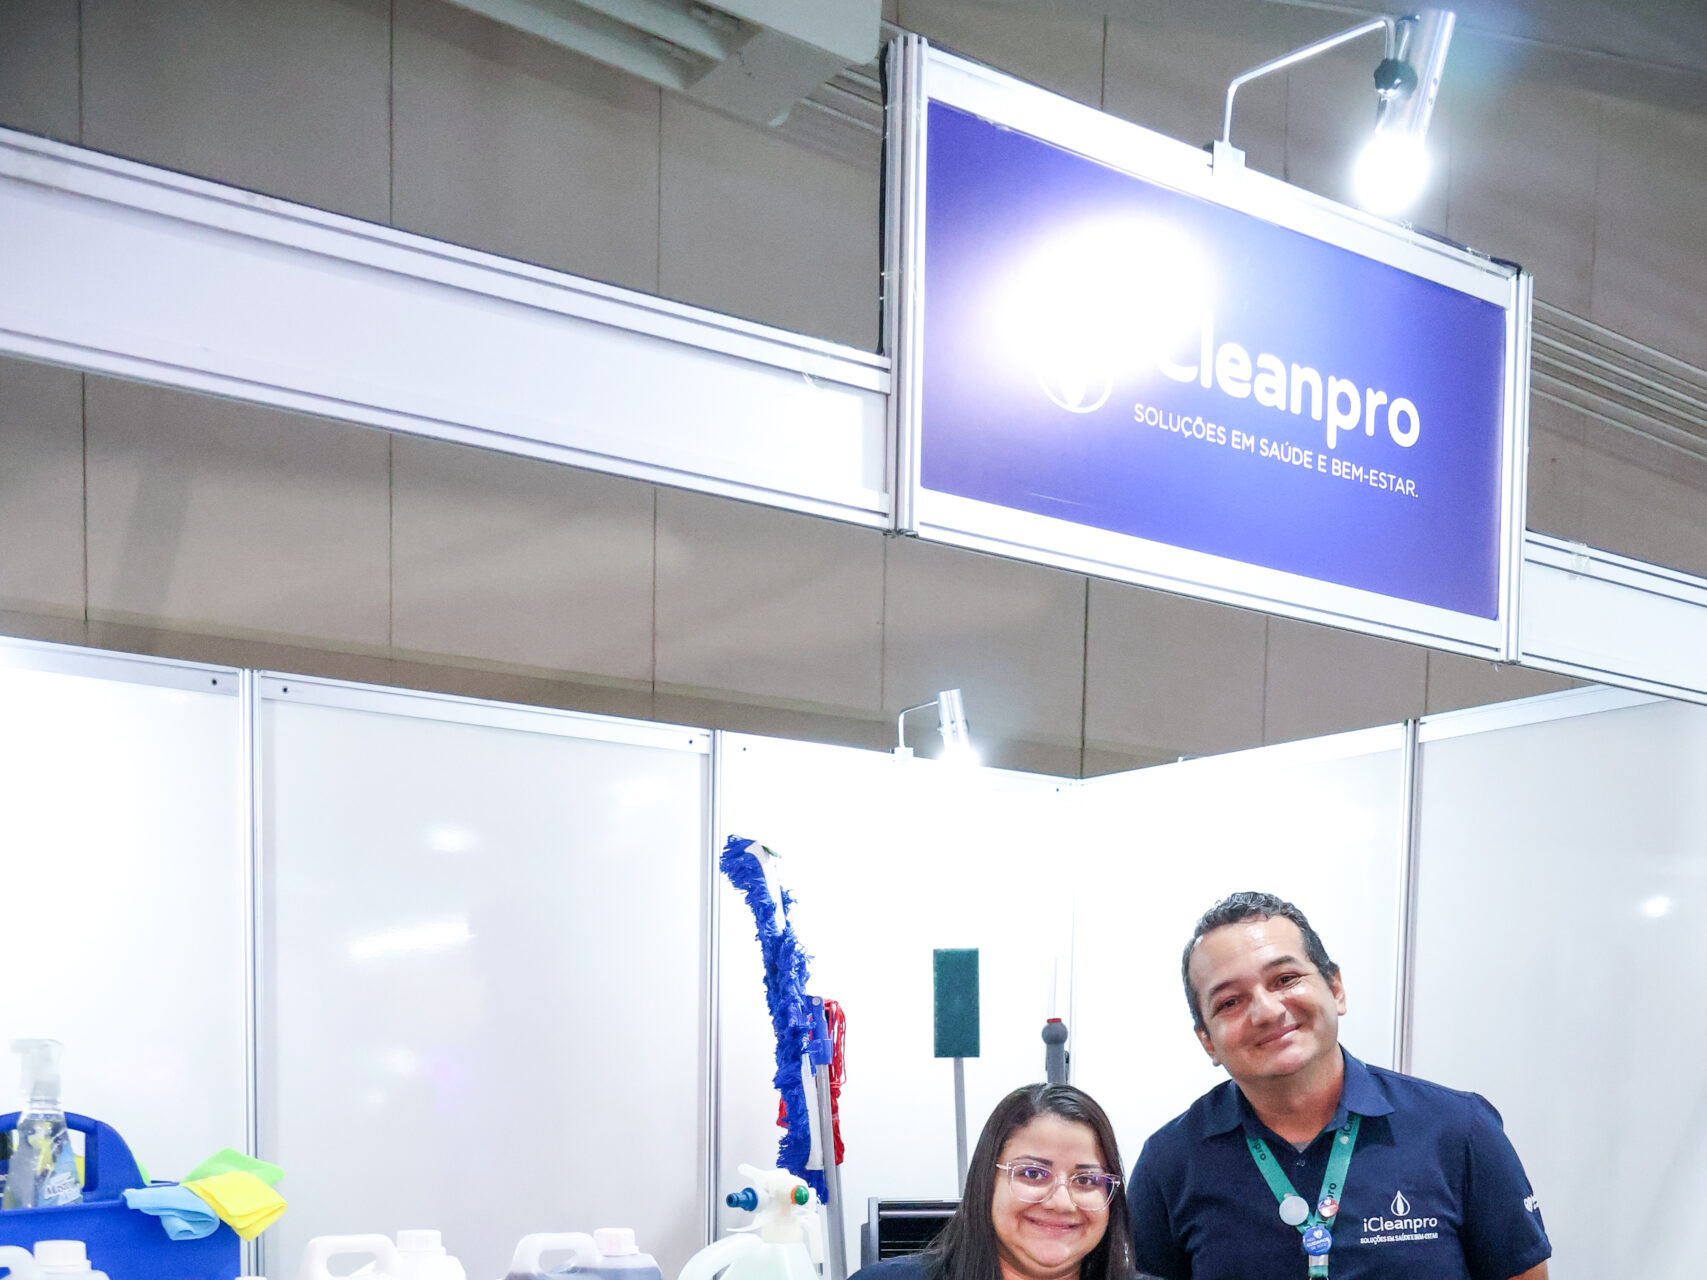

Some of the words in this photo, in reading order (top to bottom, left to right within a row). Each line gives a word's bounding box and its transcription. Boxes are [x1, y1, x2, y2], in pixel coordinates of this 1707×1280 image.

[1134, 403, 1227, 446] SOLUÇÕES
[1231, 430, 1255, 453] EM
[1259, 439, 1313, 470] SAÚDE
[1317, 454, 1328, 473] E
[1332, 458, 1419, 498] BEM-ESTAR.
[1363, 1216, 1438, 1233] iCleanpro
